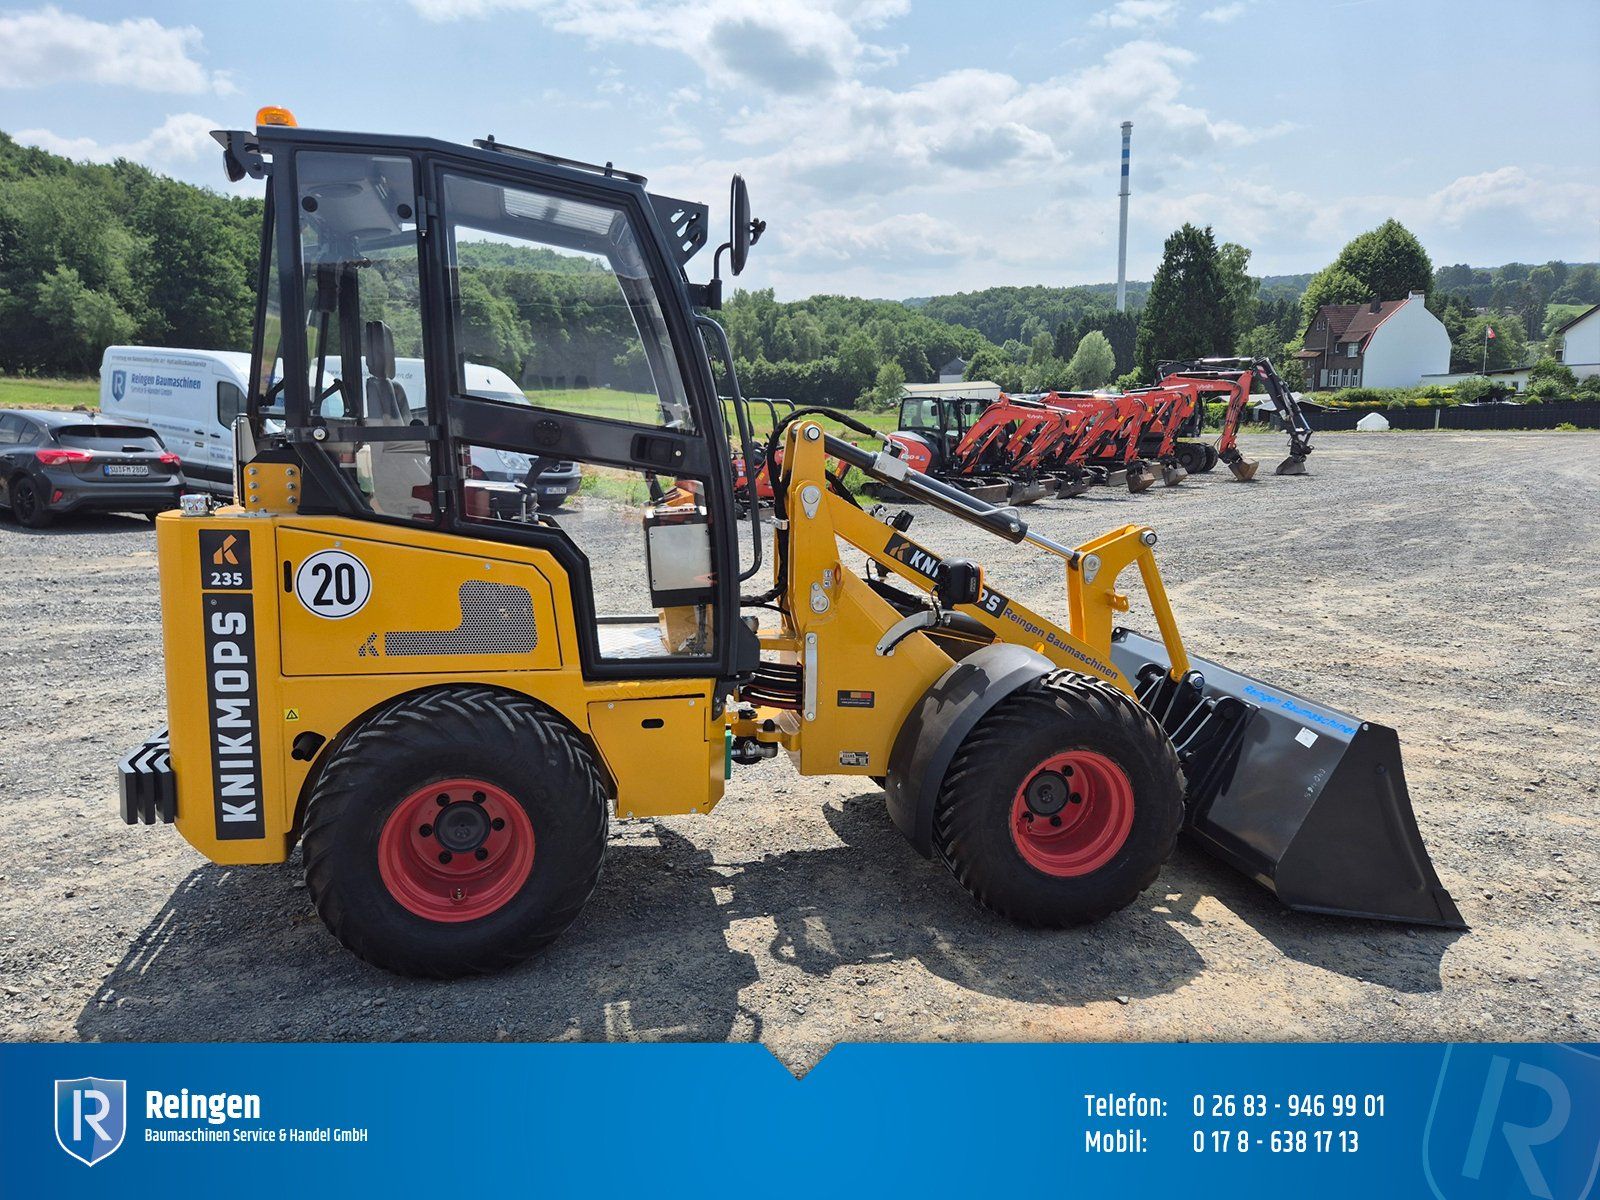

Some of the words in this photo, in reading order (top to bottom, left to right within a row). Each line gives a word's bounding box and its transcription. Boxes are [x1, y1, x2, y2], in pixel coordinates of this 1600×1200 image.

[132, 373, 154, 386] Reingen
[155, 375, 201, 390] Baumaschinen
[210, 572, 243, 586] 235
[311, 562, 357, 606] 20
[1003, 608, 1045, 637] Reingen
[1046, 632, 1118, 680] Baumaschinen
[1244, 685, 1282, 704] Reingen
[212, 611, 258, 822] KNIKMOPS
